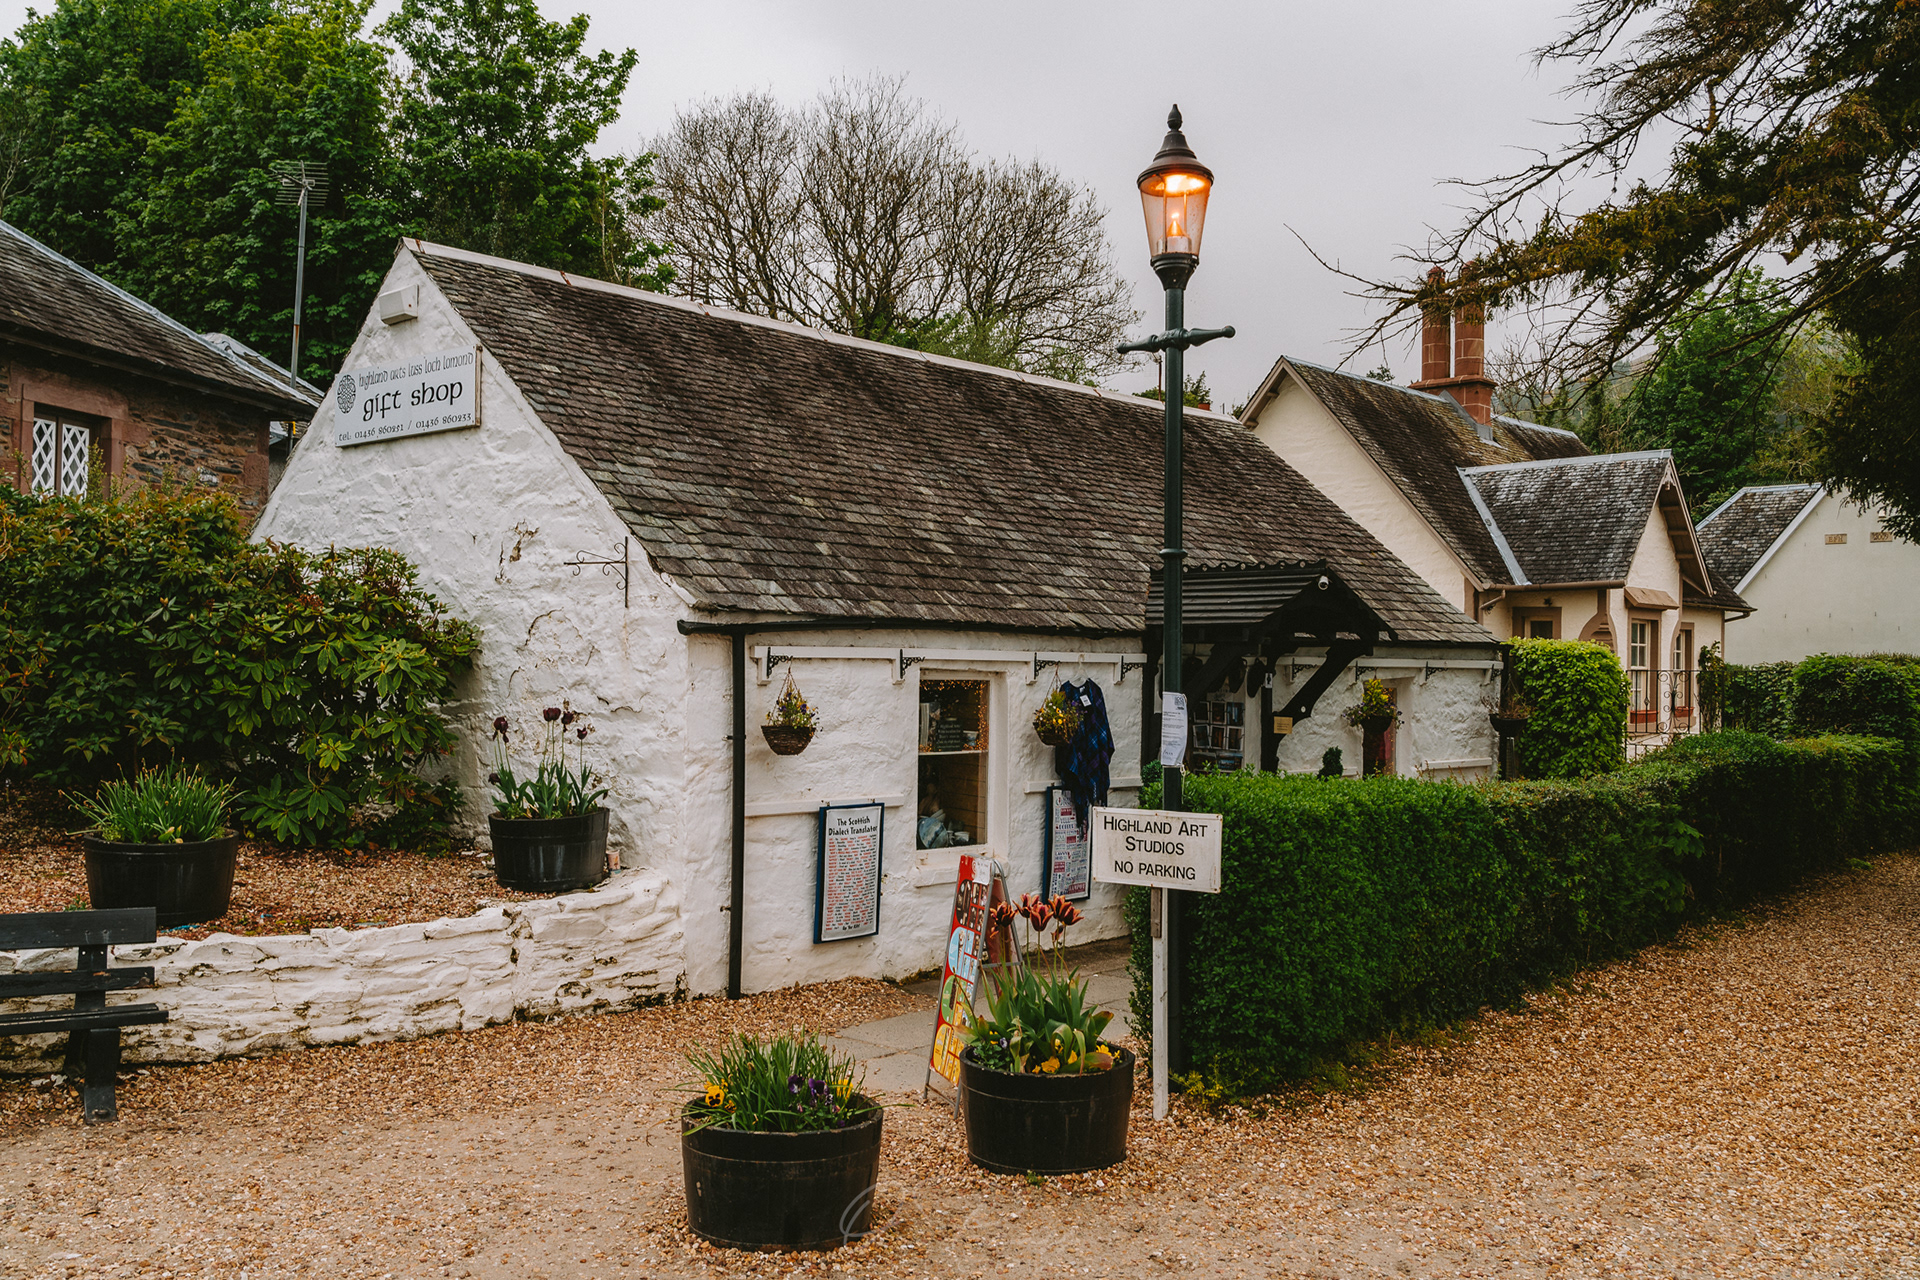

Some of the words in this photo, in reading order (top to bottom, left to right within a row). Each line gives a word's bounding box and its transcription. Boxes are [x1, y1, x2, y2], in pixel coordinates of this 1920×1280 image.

[358, 370, 388, 390] highland
[389, 367, 406, 381] arts
[408, 362, 423, 378] luss
[424, 356, 441, 374] loch
[442, 352, 474, 370] lomond
[362, 390, 402, 422] gift
[411, 381, 463, 406] shop
[354, 427, 376, 440] 01436
[415, 417, 439, 429] 01436
[442, 412, 472, 425] 860233
[828, 828, 849, 836] Dialect
[850, 825, 878, 835] Translator
[837, 818, 847, 826] The
[848, 816, 871, 826] Scottish
[1114, 860, 1134, 874] NO
[1138, 862, 1196, 880] PARKING
